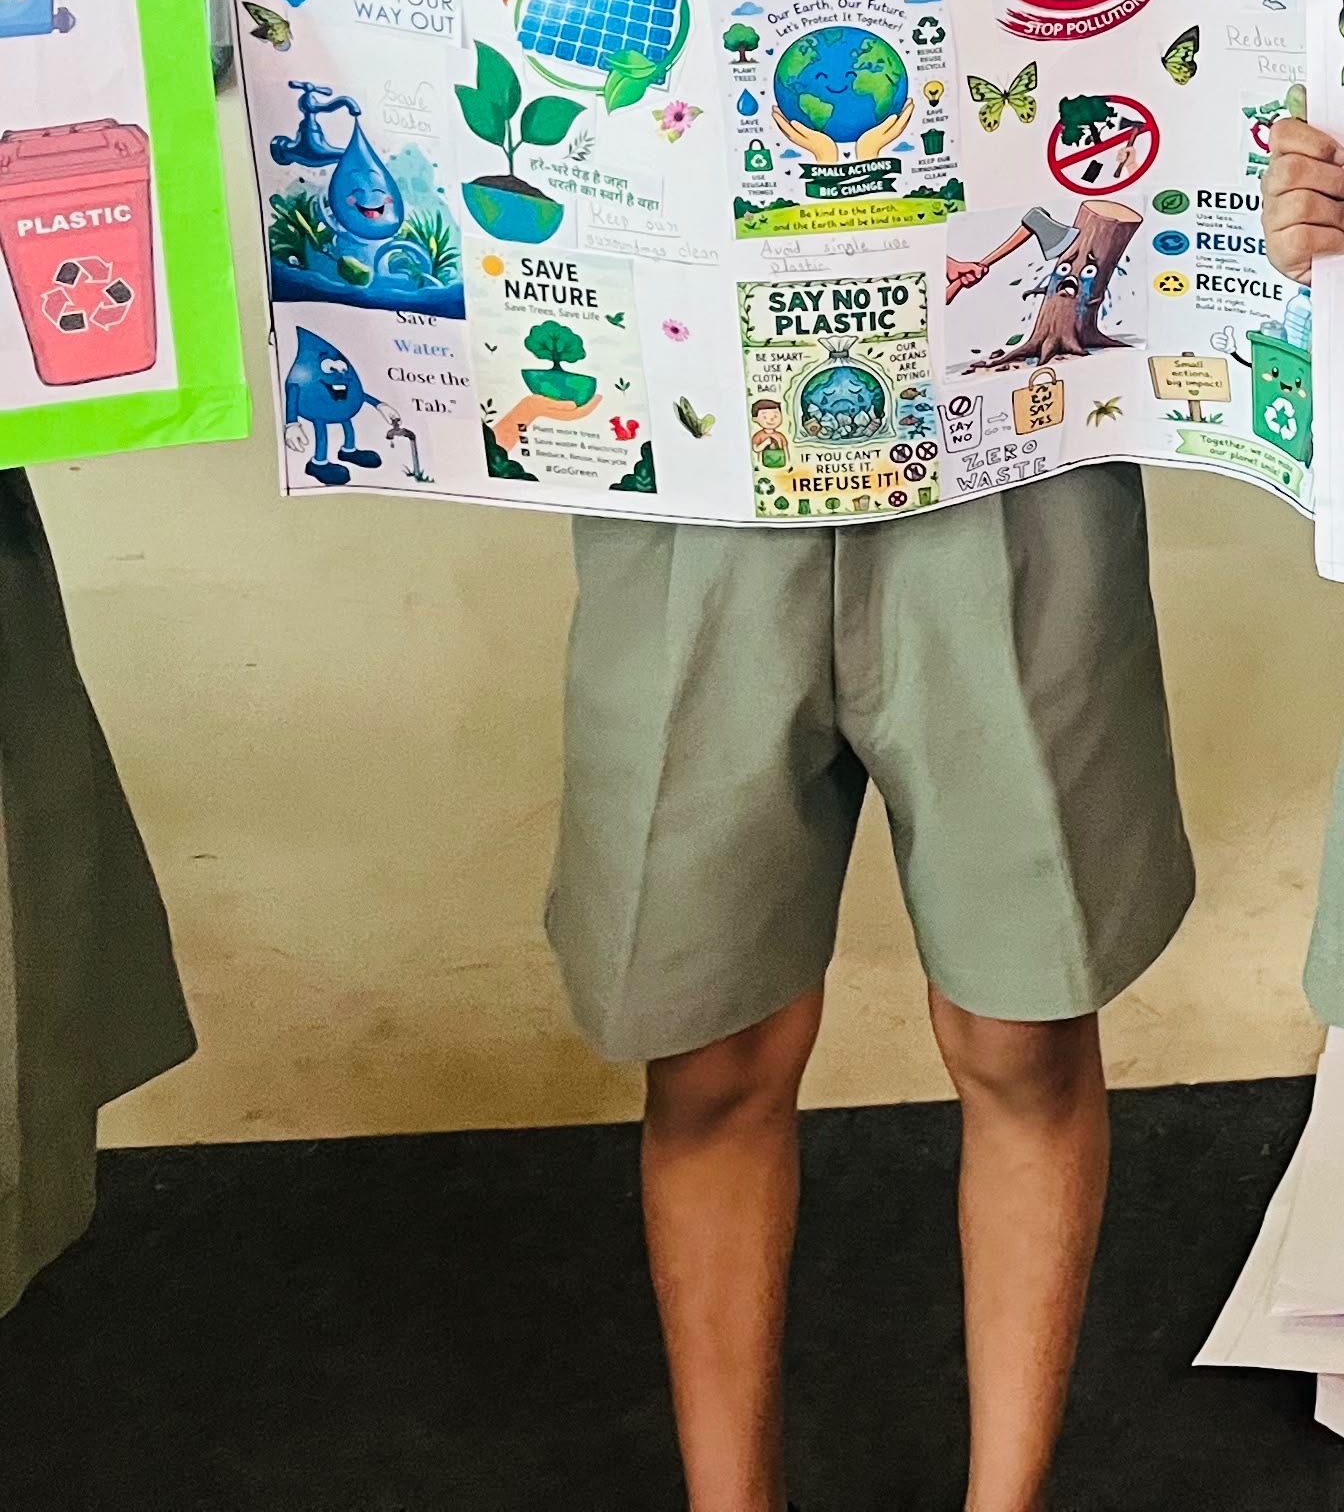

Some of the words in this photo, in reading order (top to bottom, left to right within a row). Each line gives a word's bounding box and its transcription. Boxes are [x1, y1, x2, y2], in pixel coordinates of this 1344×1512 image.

[354, 0, 401, 26] WAY
[411, 12, 454, 34] OUT
[768, 8, 789, 24] Our
[793, 0, 833, 18] Earth,
[1023, 20, 1064, 37] STOP
[811, 165, 846, 177] SMALL
[848, 161, 892, 175] ACTIONS
[819, 185, 838, 197] BIG
[841, 181, 884, 196] CHANGE
[16, 204, 132, 237] PLASTIC
[521, 258, 579, 282] SAVE
[505, 281, 599, 308] NATURE
[768, 289, 824, 313] SAY
[833, 288, 871, 311] NO
[877, 285, 909, 306] TO
[1196, 273, 1283, 301] RECYCLE
[775, 309, 896, 336] PLASTIC
